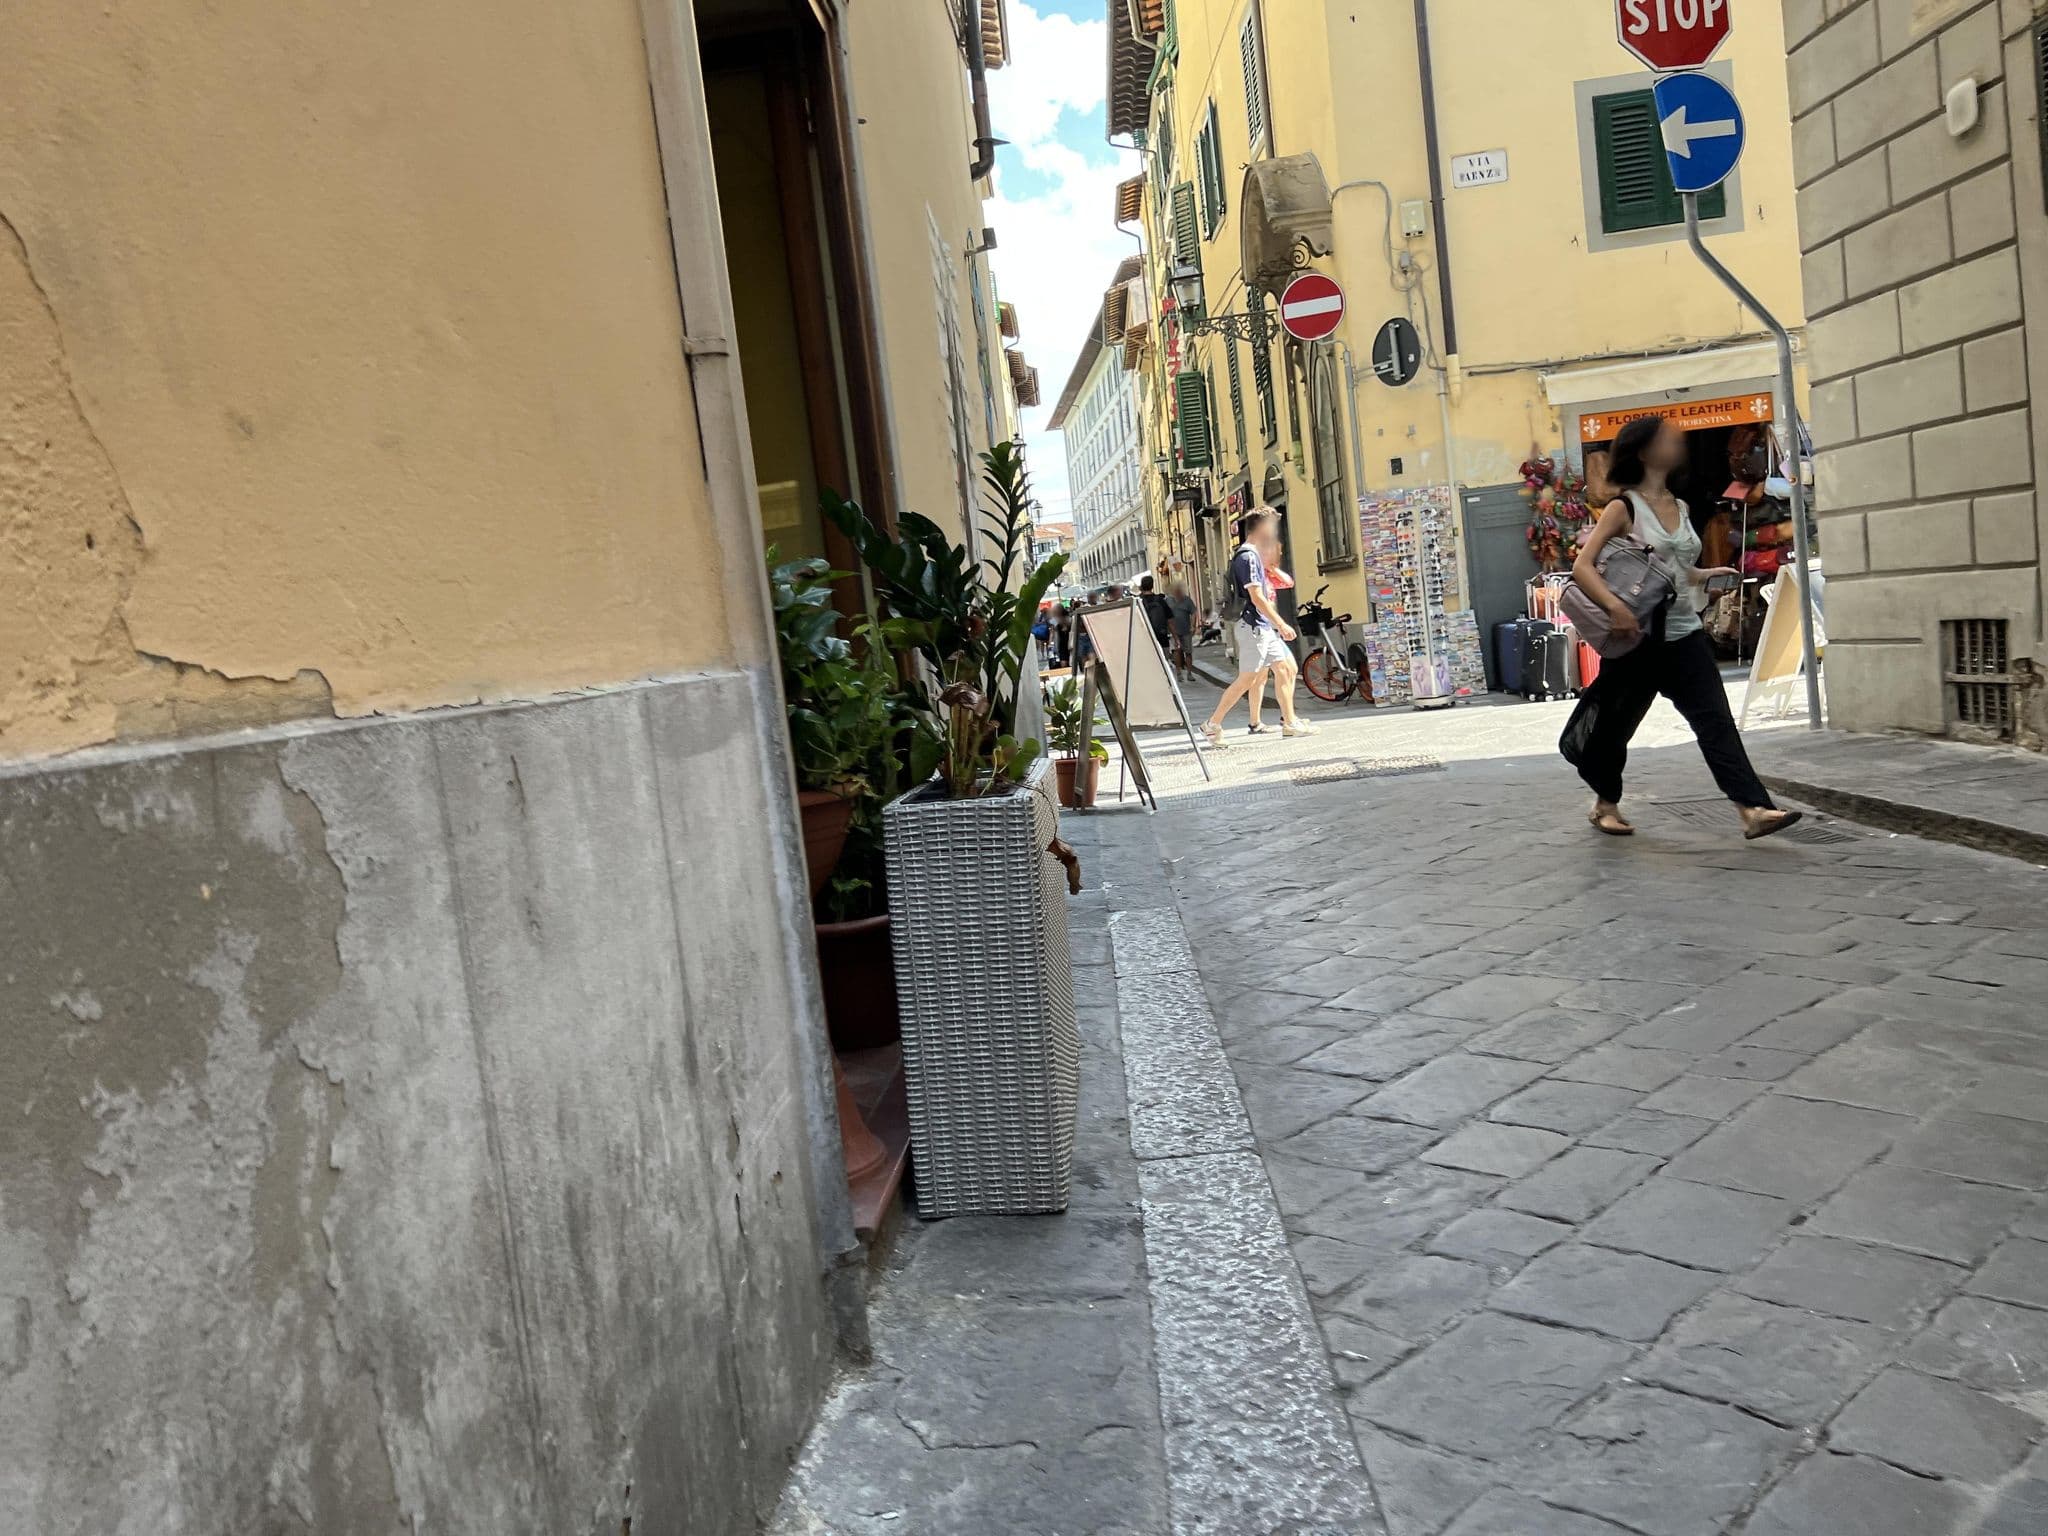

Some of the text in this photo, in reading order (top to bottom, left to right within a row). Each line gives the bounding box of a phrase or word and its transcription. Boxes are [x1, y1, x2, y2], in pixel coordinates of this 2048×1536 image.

[1626, 0, 1722, 35] STOP
[1468, 156, 1490, 167] VIA
[1680, 401, 1742, 417] LEATHER
